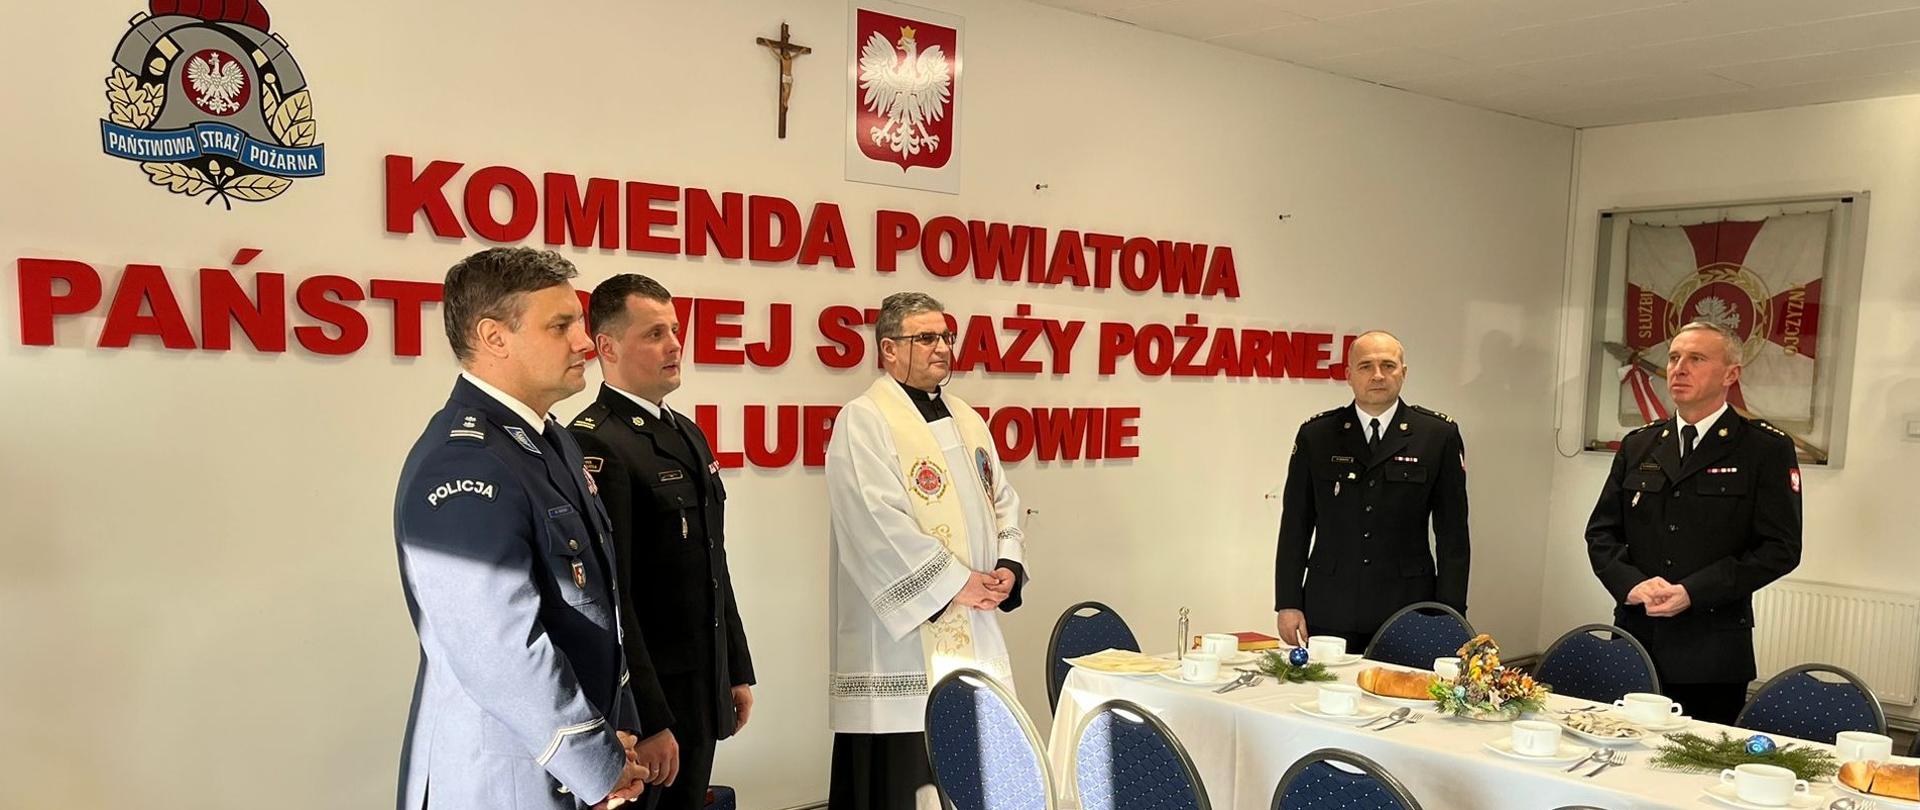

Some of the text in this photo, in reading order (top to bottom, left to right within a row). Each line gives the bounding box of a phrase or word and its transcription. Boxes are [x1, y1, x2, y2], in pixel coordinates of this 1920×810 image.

[108, 130, 318, 171] PAŃSTWOWA STRAŻ POŻARNA
[384, 154, 1241, 298] KOMENDA POWIATOWA
[16, 248, 793, 368] PAŃSTEJ
[816, 303, 1085, 375] SAŻY
[695, 404, 1141, 469] LUBOWIE
[427, 479, 494, 507] POLICJA
